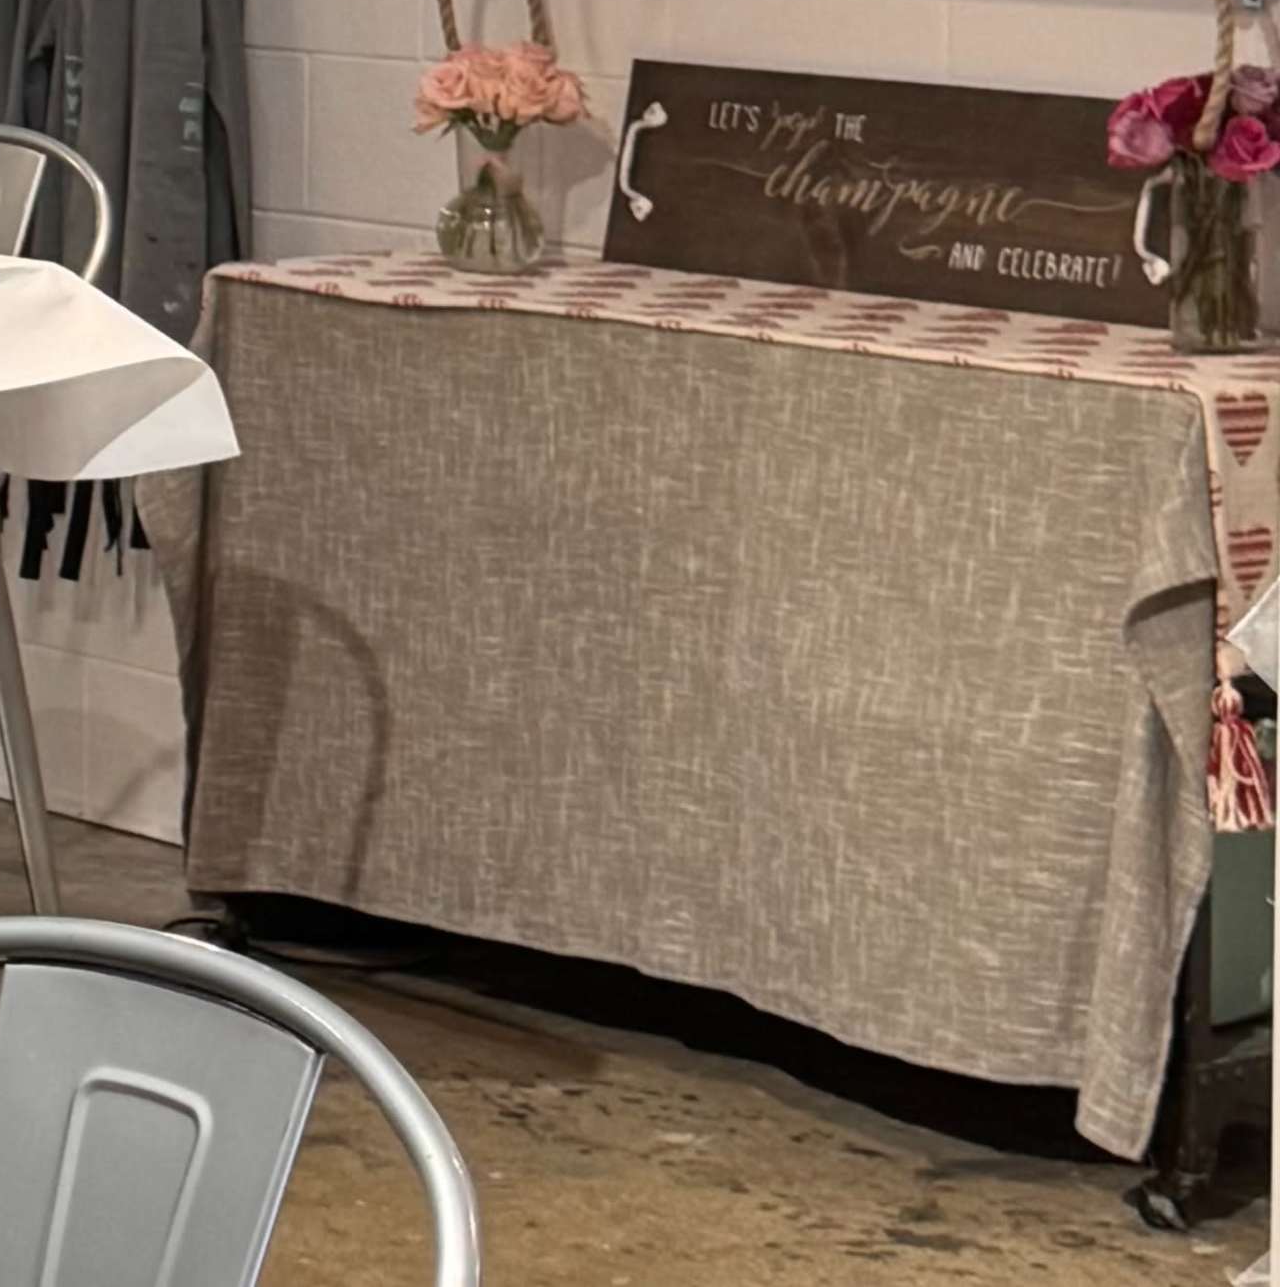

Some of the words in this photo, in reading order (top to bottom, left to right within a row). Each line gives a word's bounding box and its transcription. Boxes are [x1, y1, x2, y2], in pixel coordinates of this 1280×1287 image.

[708, 101, 763, 132] LET'S
[835, 112, 867, 143] THE
[750, 138, 1040, 237] champagne
[948, 240, 985, 272] AND
[997, 245, 1123, 290] CELEBRATE!
